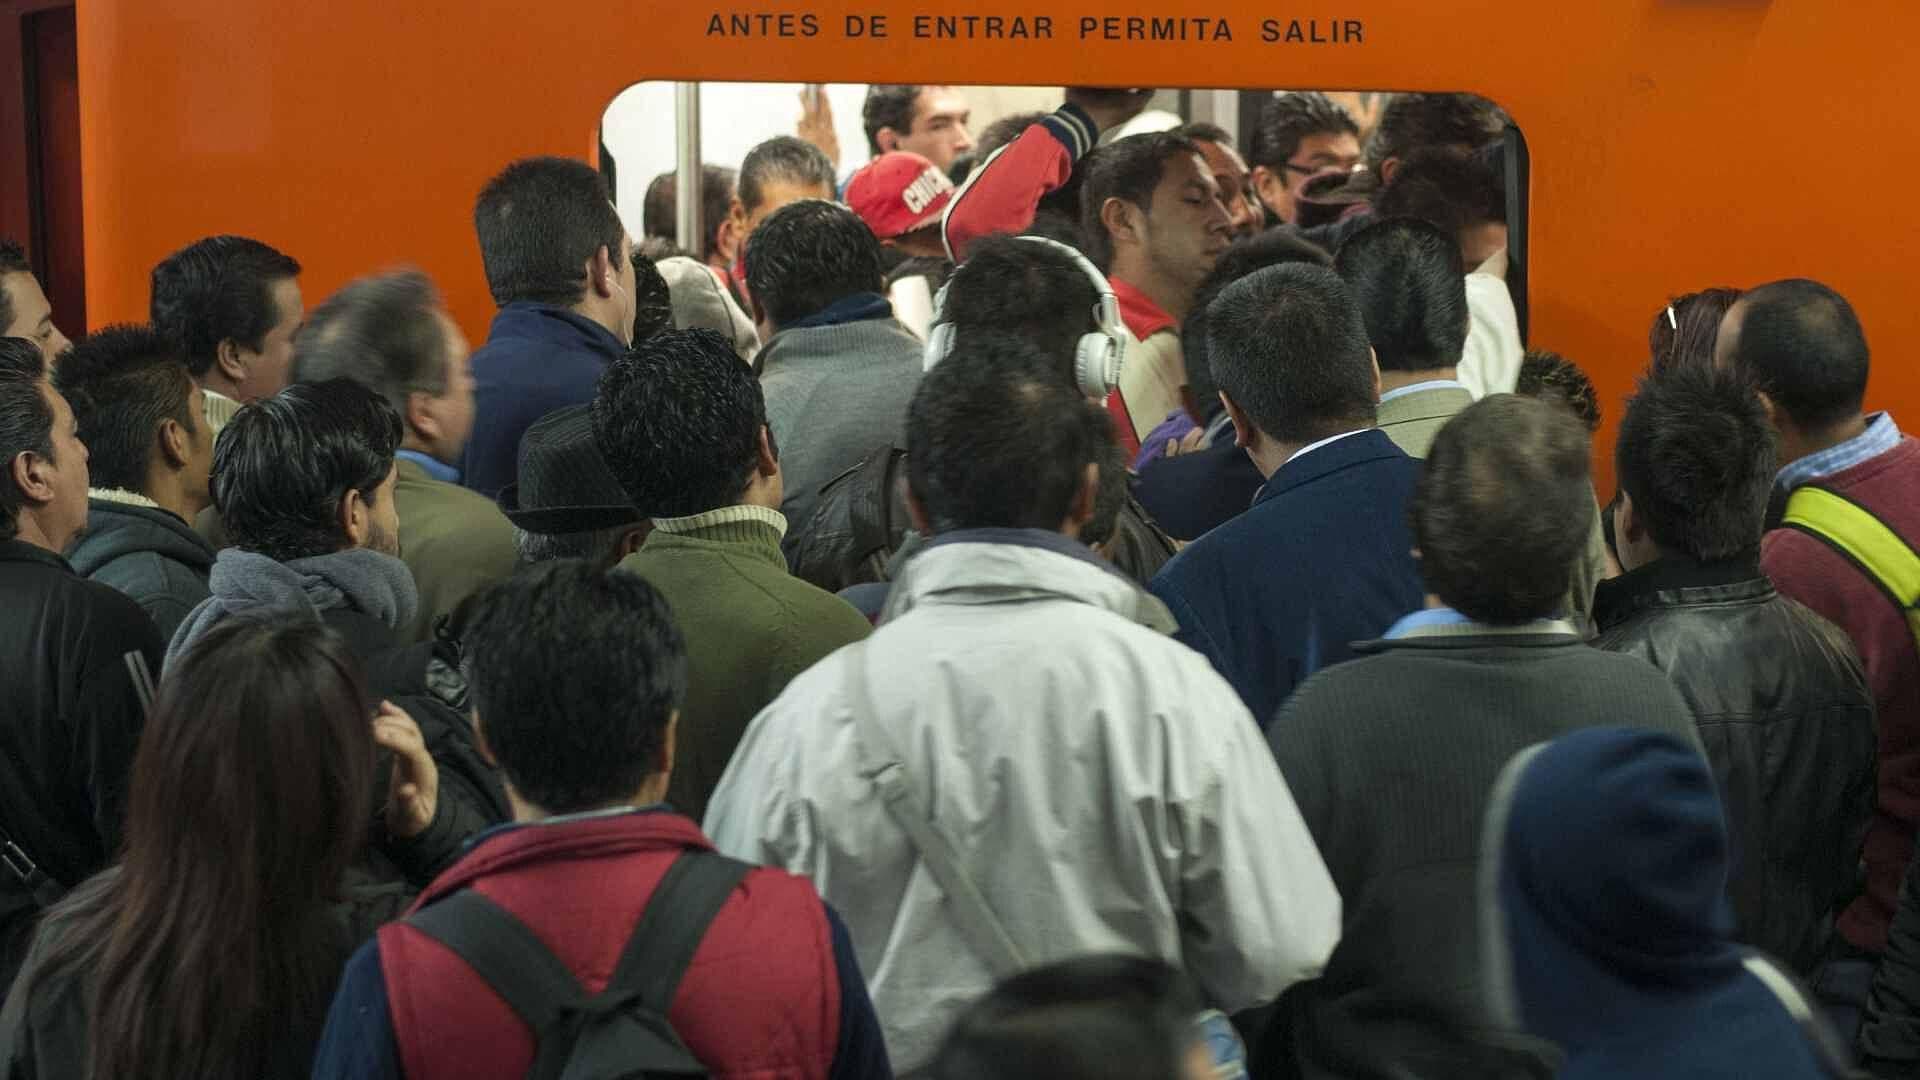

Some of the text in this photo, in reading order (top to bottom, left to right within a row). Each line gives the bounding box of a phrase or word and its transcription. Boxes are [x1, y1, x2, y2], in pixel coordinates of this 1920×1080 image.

[706, 13, 1364, 44] ANTES DE ENTRAR PERMITA SALIR
